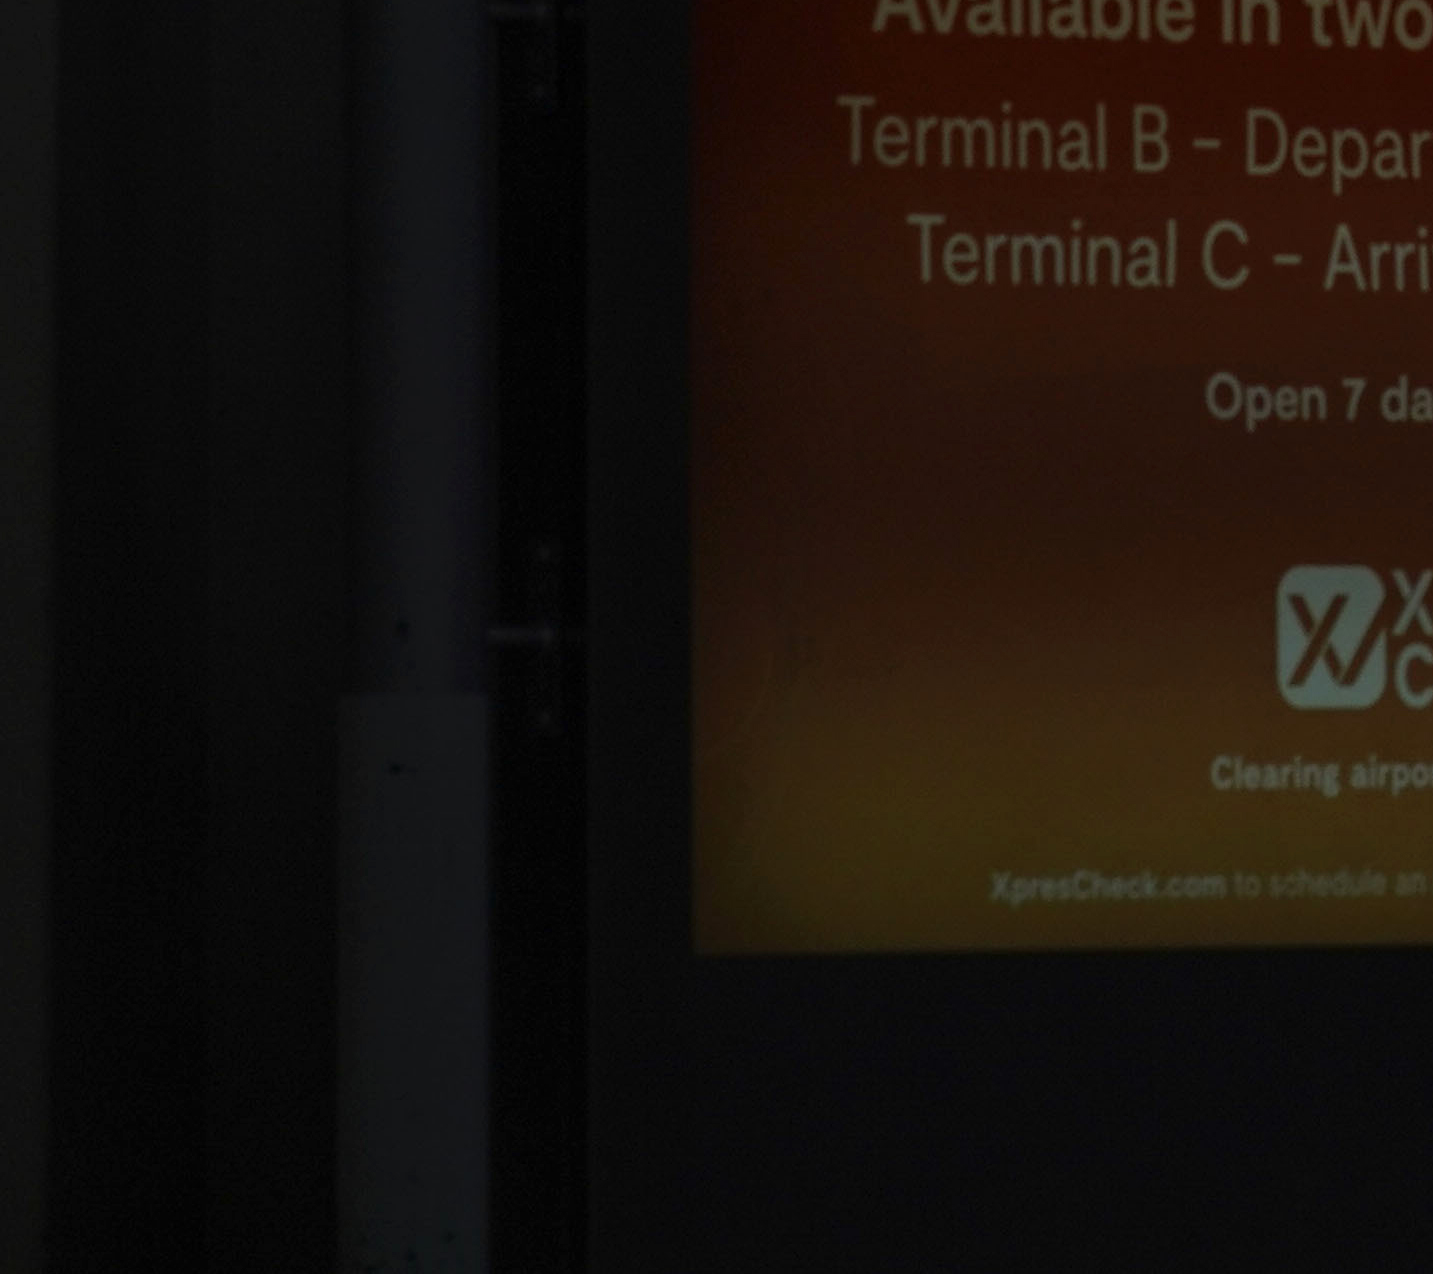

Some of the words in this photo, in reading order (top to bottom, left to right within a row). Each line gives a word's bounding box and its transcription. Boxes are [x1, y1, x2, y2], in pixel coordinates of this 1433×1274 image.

[839, 96, 1107, 172] Terminal
[1134, 104, 1170, 172] B
[907, 214, 1177, 288] Terminal
[1203, 220, 1249, 289] C
[1206, 372, 1327, 431] Open
[1342, 377, 1366, 420] 7
[1210, 753, 1340, 799] Clearing
[990, 866, 1227, 904] XpresCheck.com
